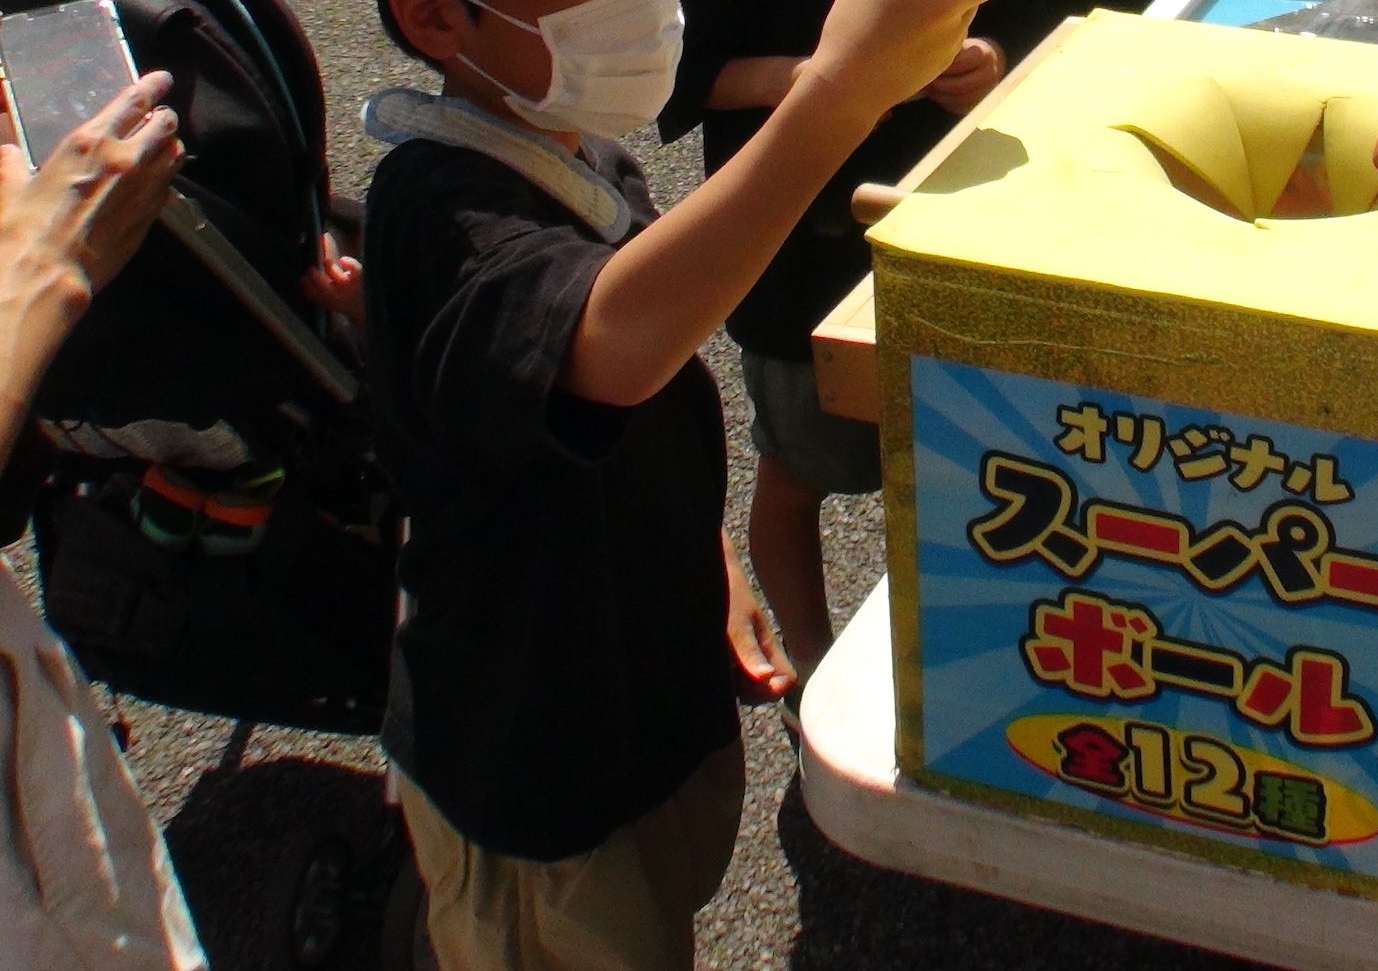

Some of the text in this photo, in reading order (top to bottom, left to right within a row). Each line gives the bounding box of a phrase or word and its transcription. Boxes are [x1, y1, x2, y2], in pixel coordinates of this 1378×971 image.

[1057, 401, 1355, 504] オリジナル
[1054, 720, 1328, 847] 全12種
